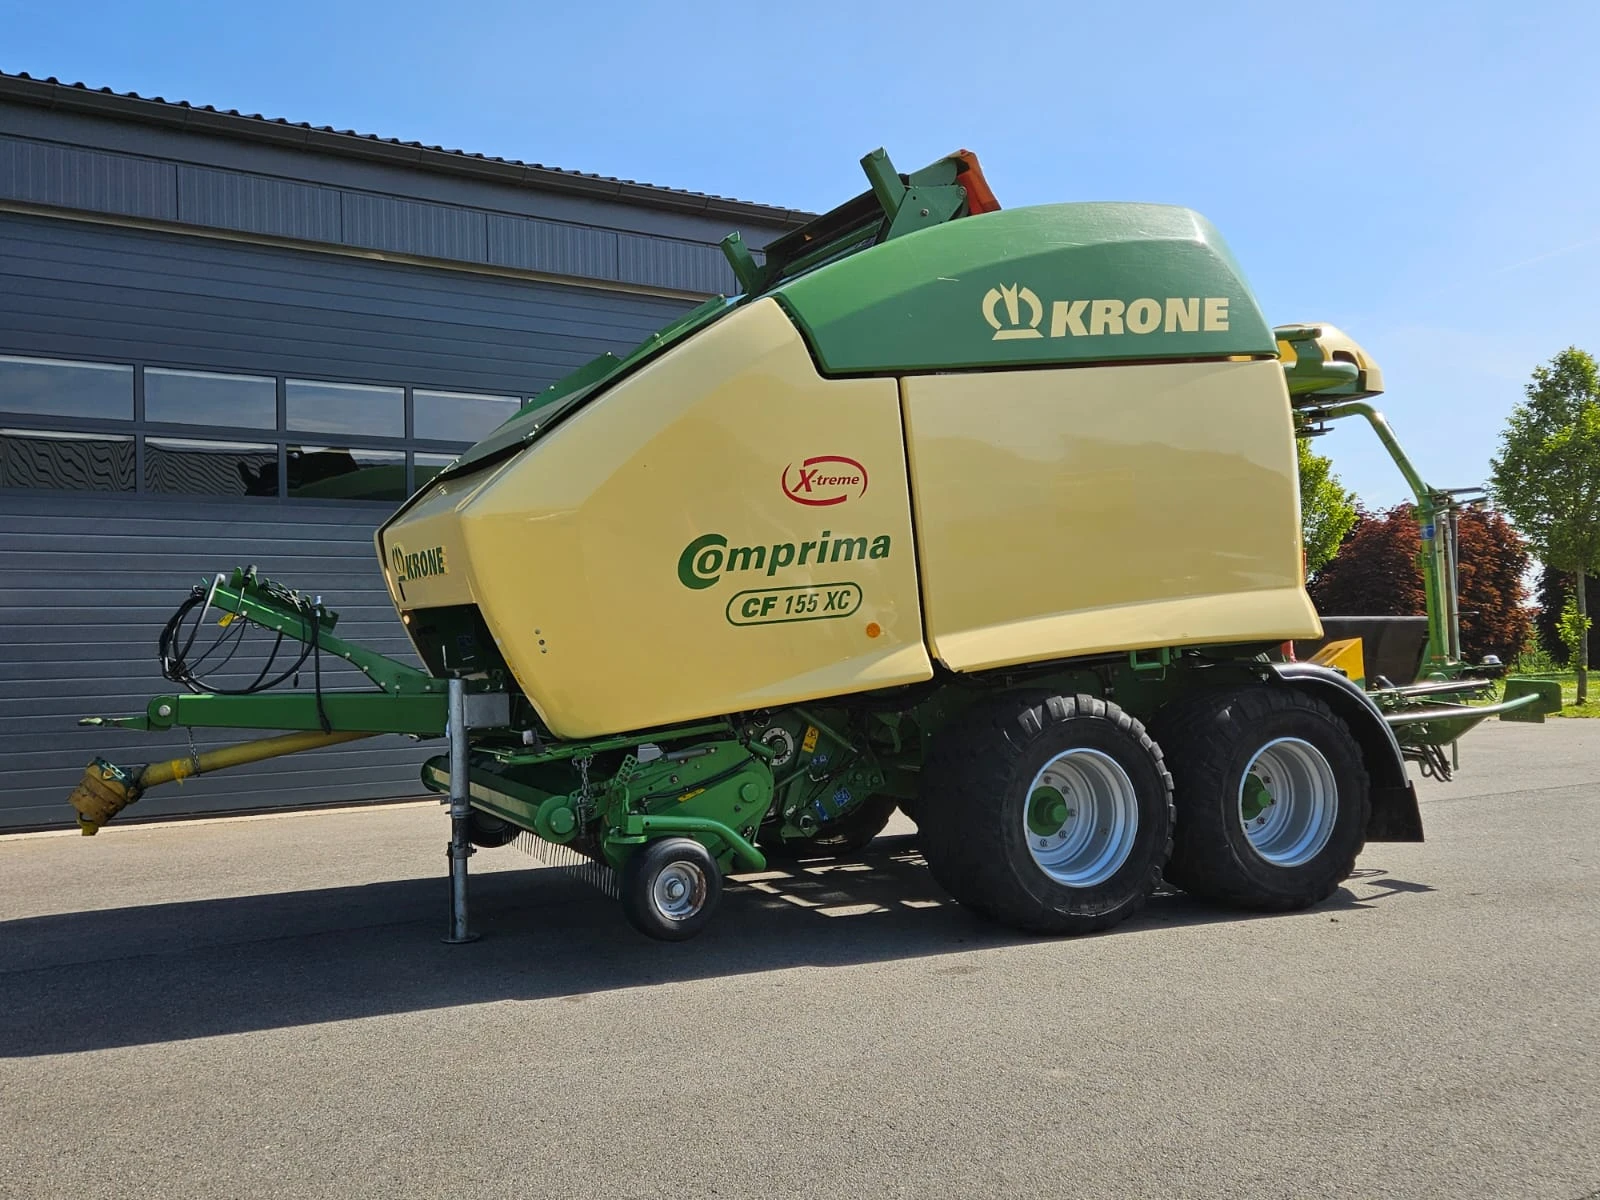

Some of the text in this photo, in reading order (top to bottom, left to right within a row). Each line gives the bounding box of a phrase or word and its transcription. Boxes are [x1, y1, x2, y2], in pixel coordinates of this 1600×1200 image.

[1050, 297, 1230, 338] KRONE
[791, 468, 860, 493] X-treme
[405, 546, 445, 580] KRONE
[677, 530, 892, 590] Comprima
[741, 590, 851, 618] CF 155 XC
